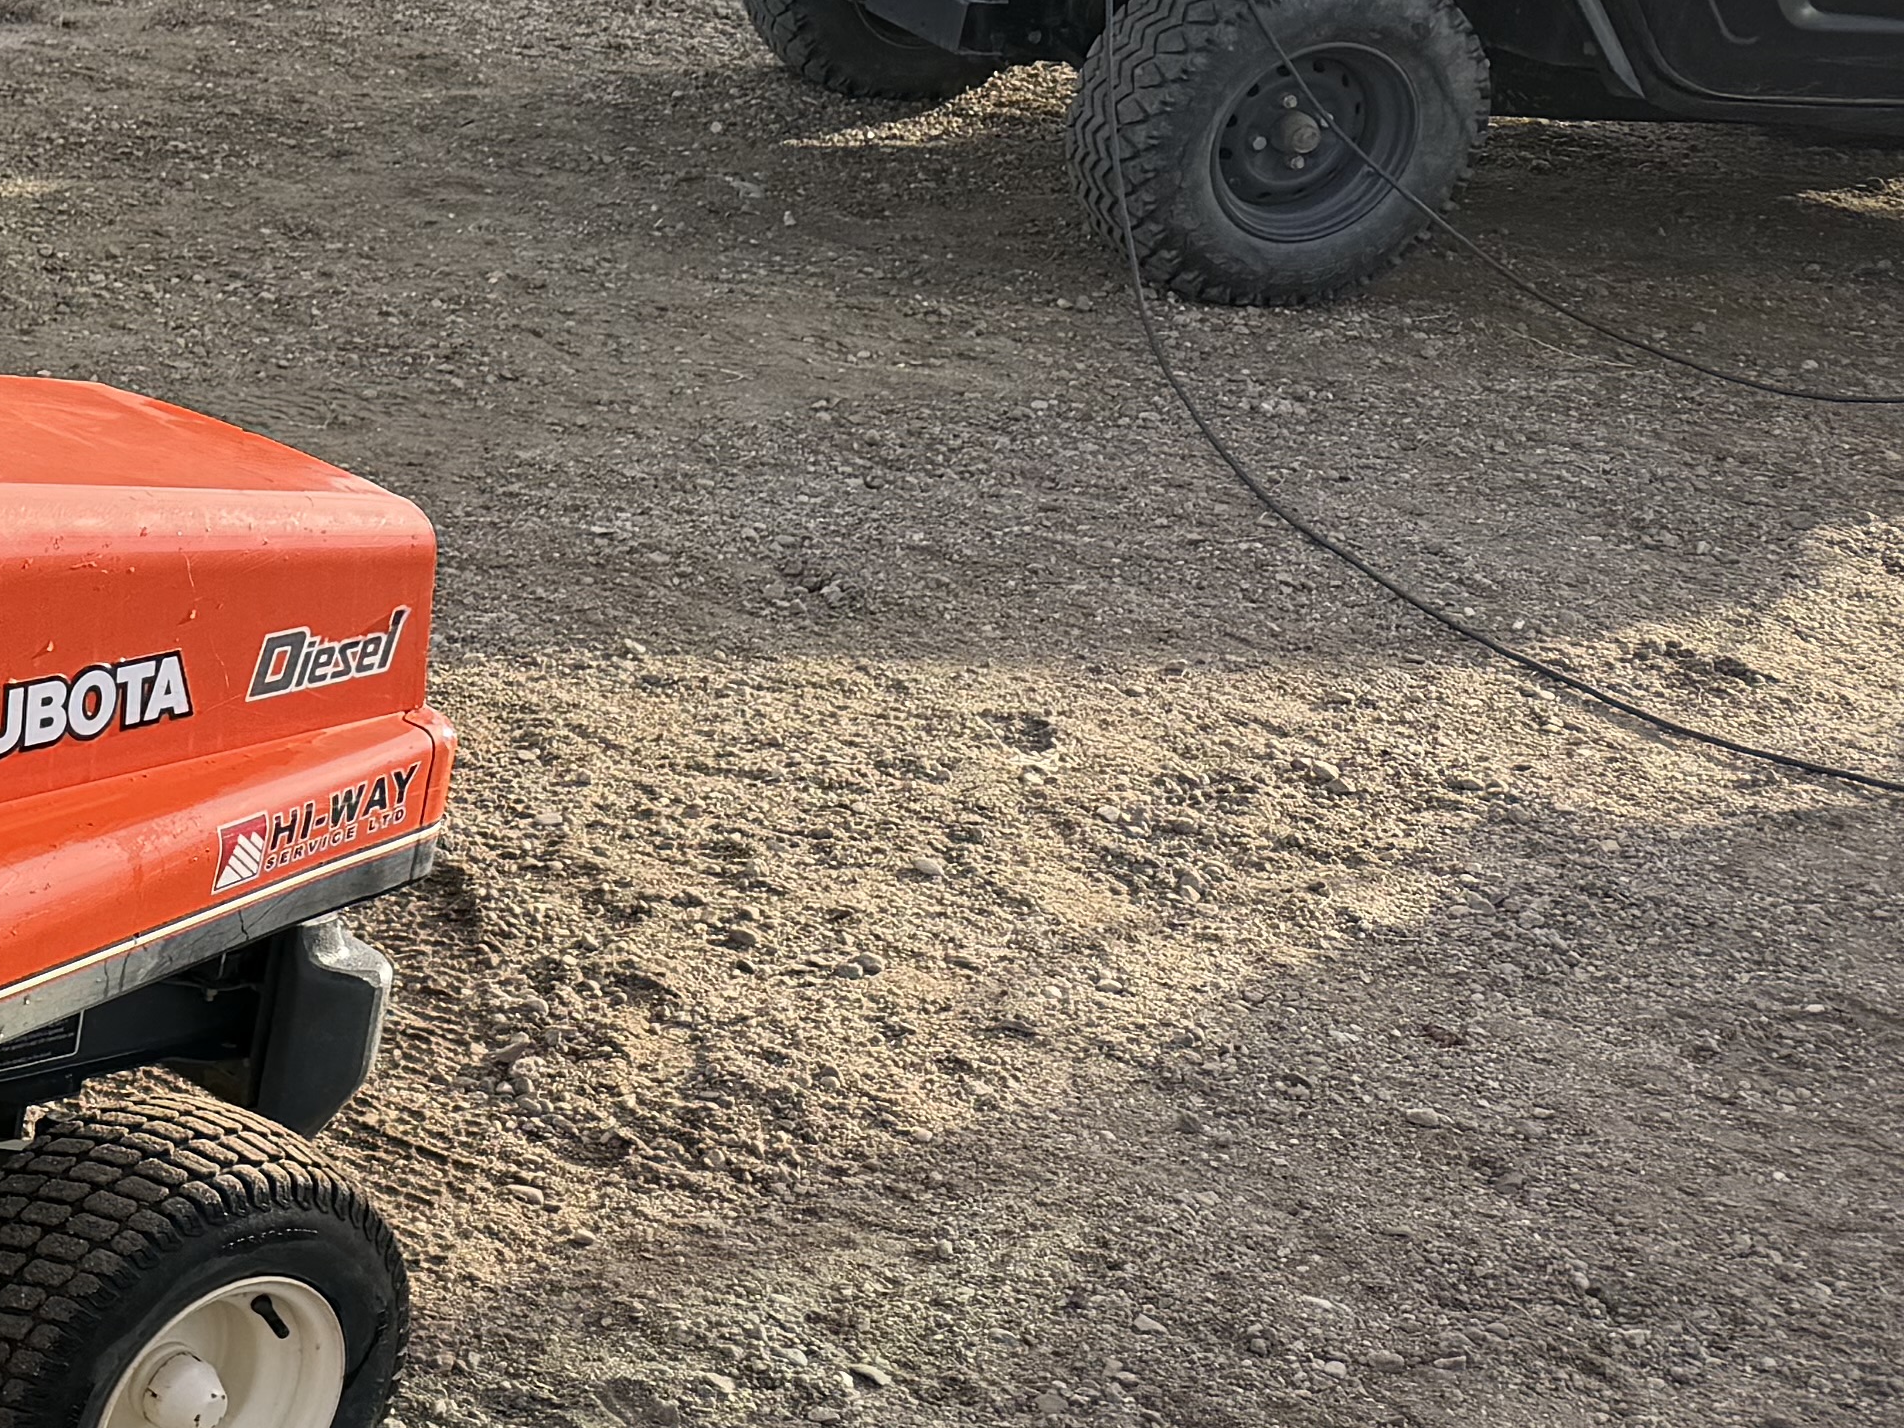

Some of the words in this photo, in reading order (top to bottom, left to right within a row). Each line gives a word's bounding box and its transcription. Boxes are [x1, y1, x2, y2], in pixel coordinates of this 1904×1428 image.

[246, 605, 411, 702] Diesel
[265, 826, 358, 872] SERVICE
[367, 805, 407, 834] LTD
[271, 761, 421, 852] HI-WAY
